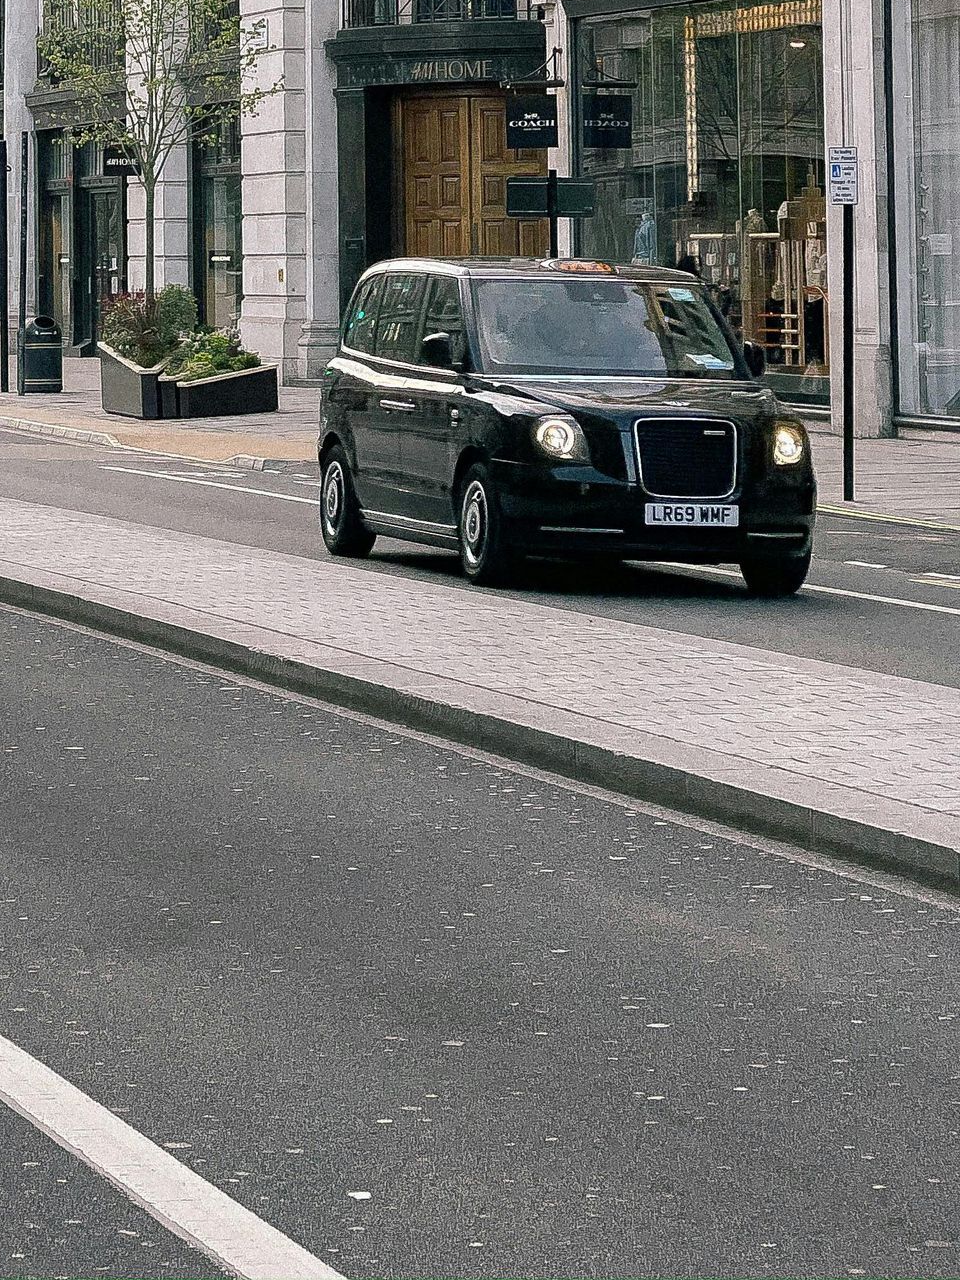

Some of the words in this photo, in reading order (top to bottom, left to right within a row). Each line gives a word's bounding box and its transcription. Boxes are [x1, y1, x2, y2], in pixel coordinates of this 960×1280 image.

[435, 60, 493, 79] HOME
[652, 506, 695, 522] LR69
[700, 507, 731, 523] WMF
